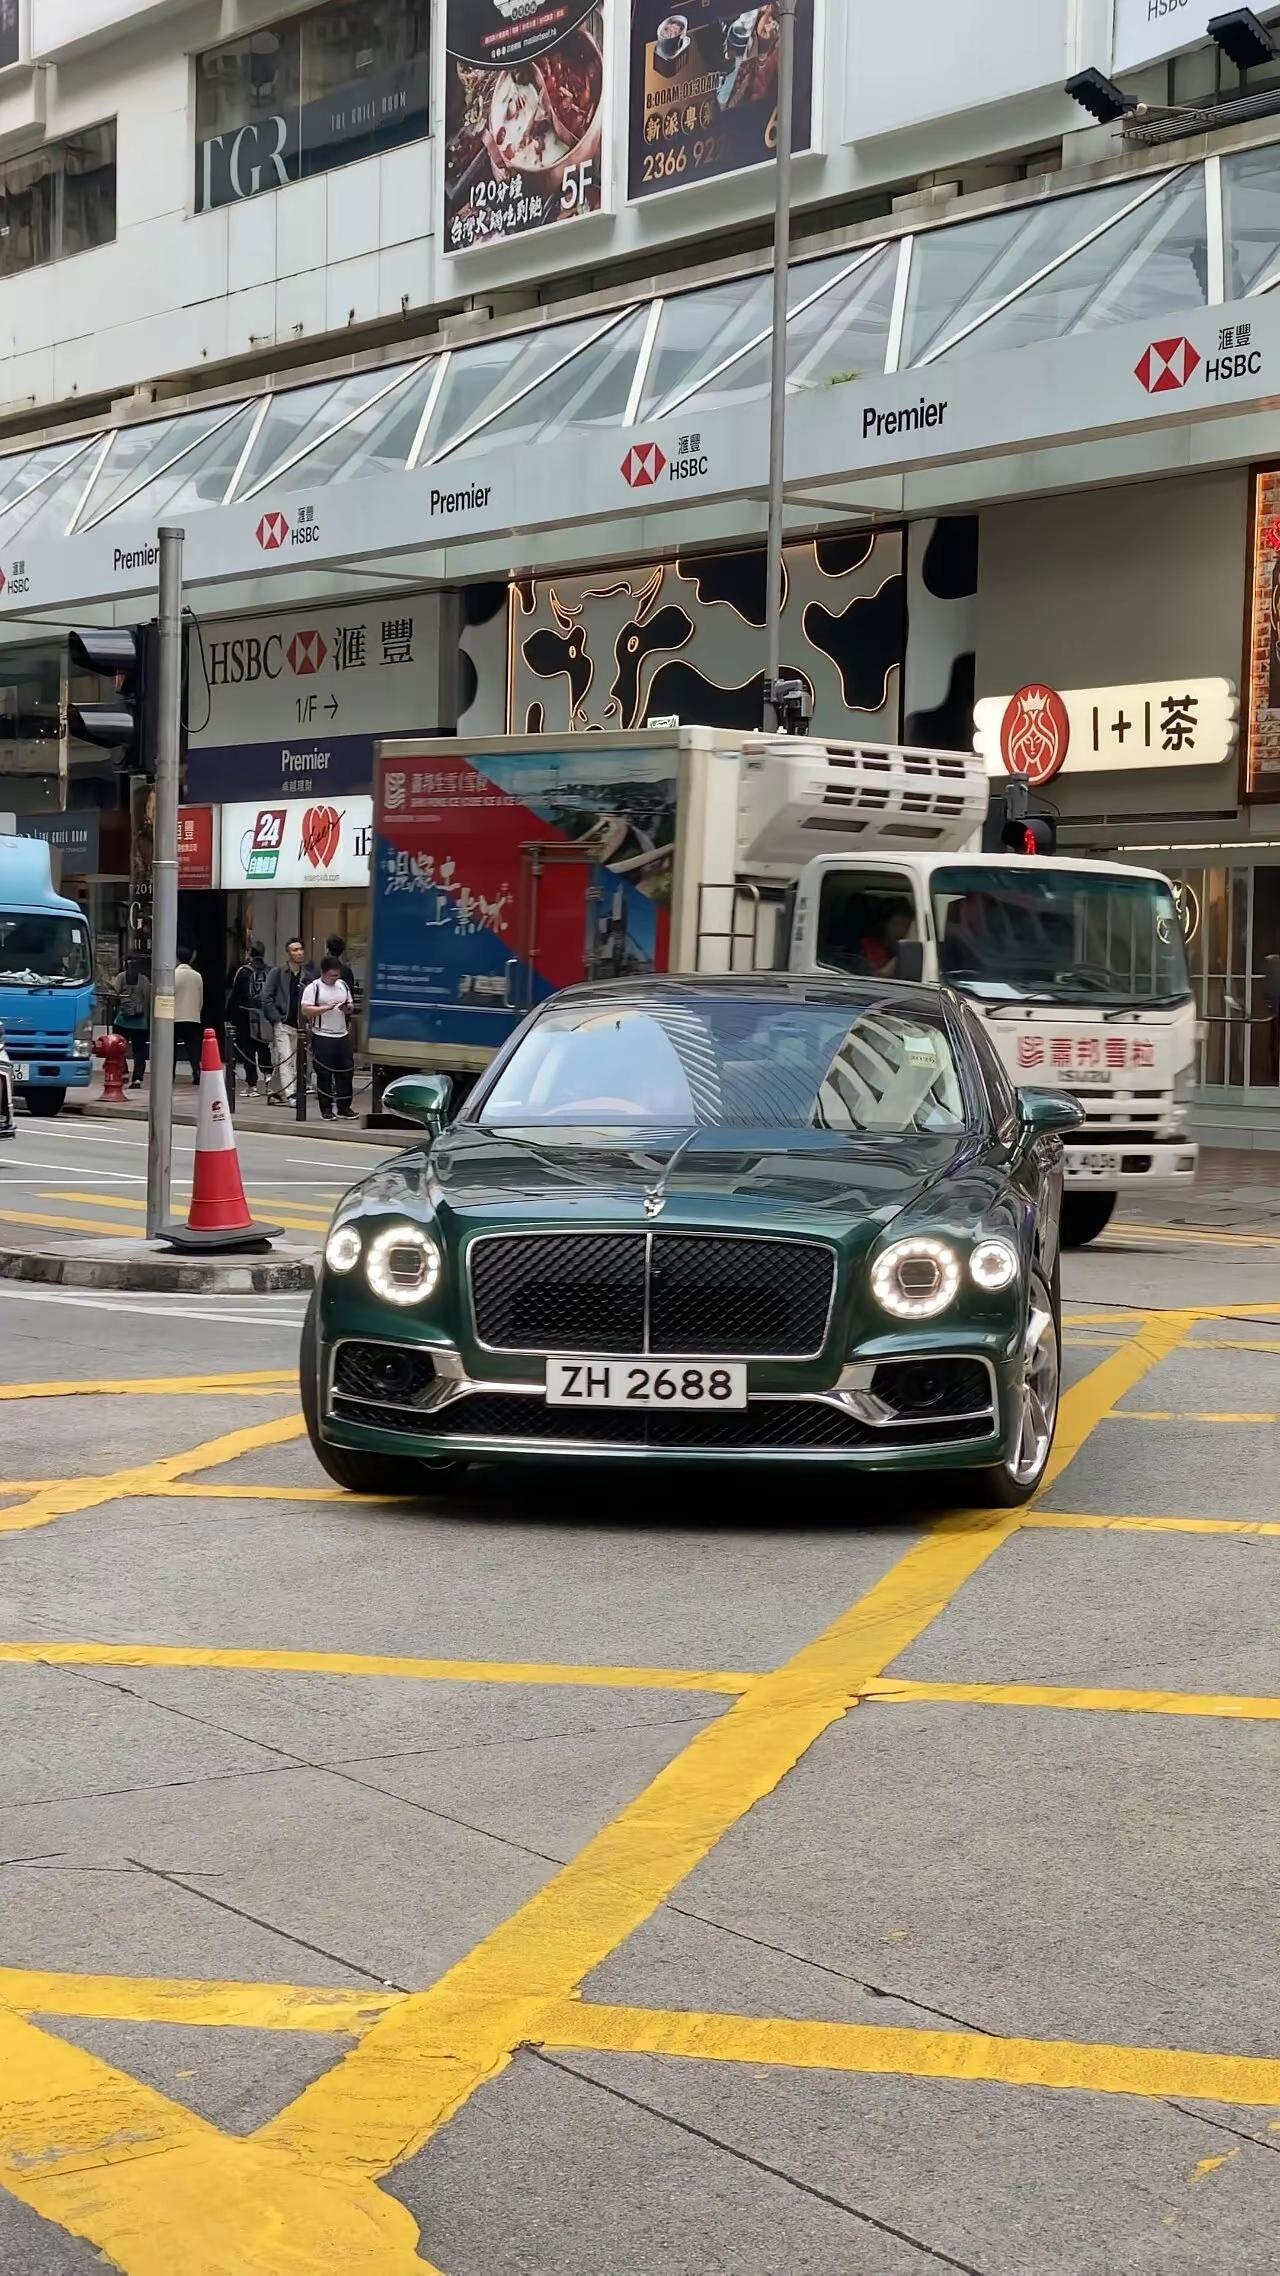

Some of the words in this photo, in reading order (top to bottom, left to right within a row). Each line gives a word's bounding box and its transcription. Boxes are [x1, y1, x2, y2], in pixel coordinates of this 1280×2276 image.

[1147, 0, 1188, 21] HSB
[381, 90, 406, 113] ROOM
[642, 145, 687, 182] 2366
[693, 135, 725, 168] 92
[561, 159, 593, 209] 5F
[1205, 351, 1262, 382] HSBC
[862, 397, 948, 439] Premier
[669, 456, 708, 481] HSBC
[430, 482, 491, 516] Premier
[291, 525, 320, 545] HSBC
[113, 543, 160, 571] Premier
[8, 577, 30, 594] HSBC
[208, 634, 283, 685] HSBC
[296, 694, 318, 723] 1/F
[281, 747, 331, 772] Premier
[71, 830, 88, 842] ROOM
[257, 813, 281, 846] 24
[560, 1366, 610, 1398] ZH
[626, 1368, 733, 1400] 2688
